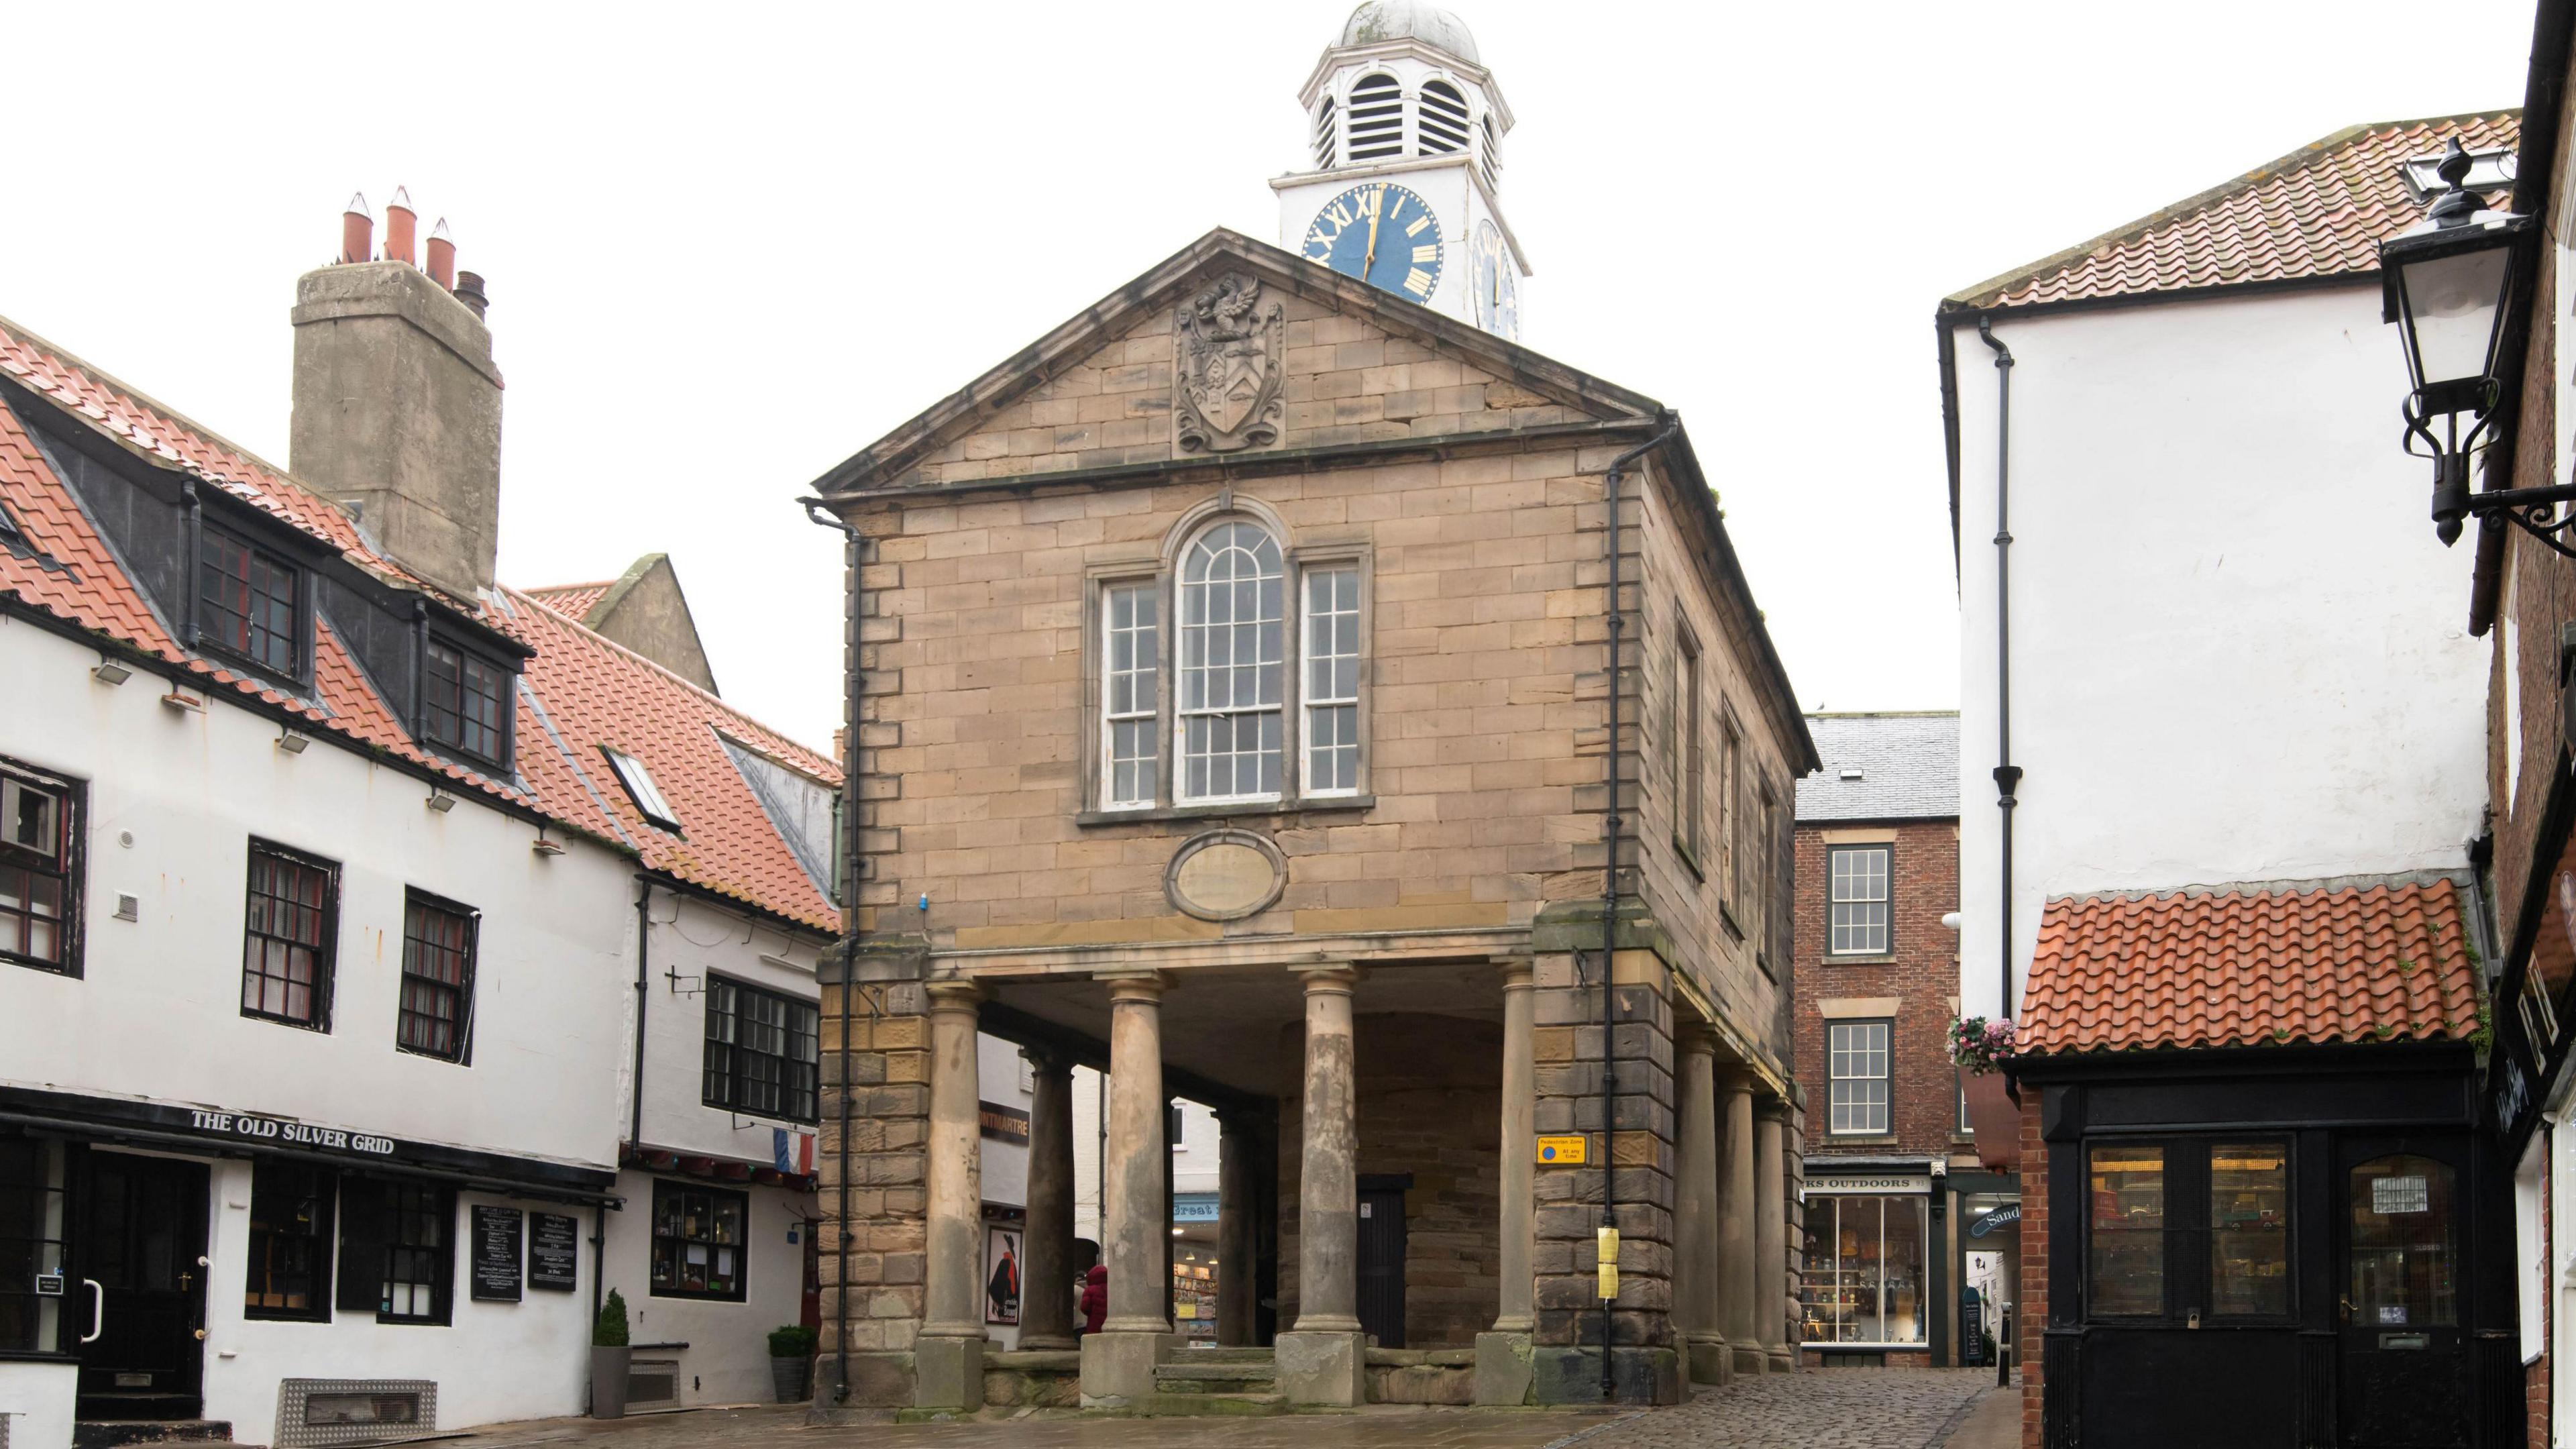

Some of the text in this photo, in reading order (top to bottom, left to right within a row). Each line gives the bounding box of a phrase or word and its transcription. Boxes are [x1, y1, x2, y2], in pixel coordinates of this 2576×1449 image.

[192, 1110, 394, 1154] THE OLD SILVER GRID
[1829, 1179, 1910, 1187] OUTDOORS
[1986, 1206, 2021, 1226] Sand
